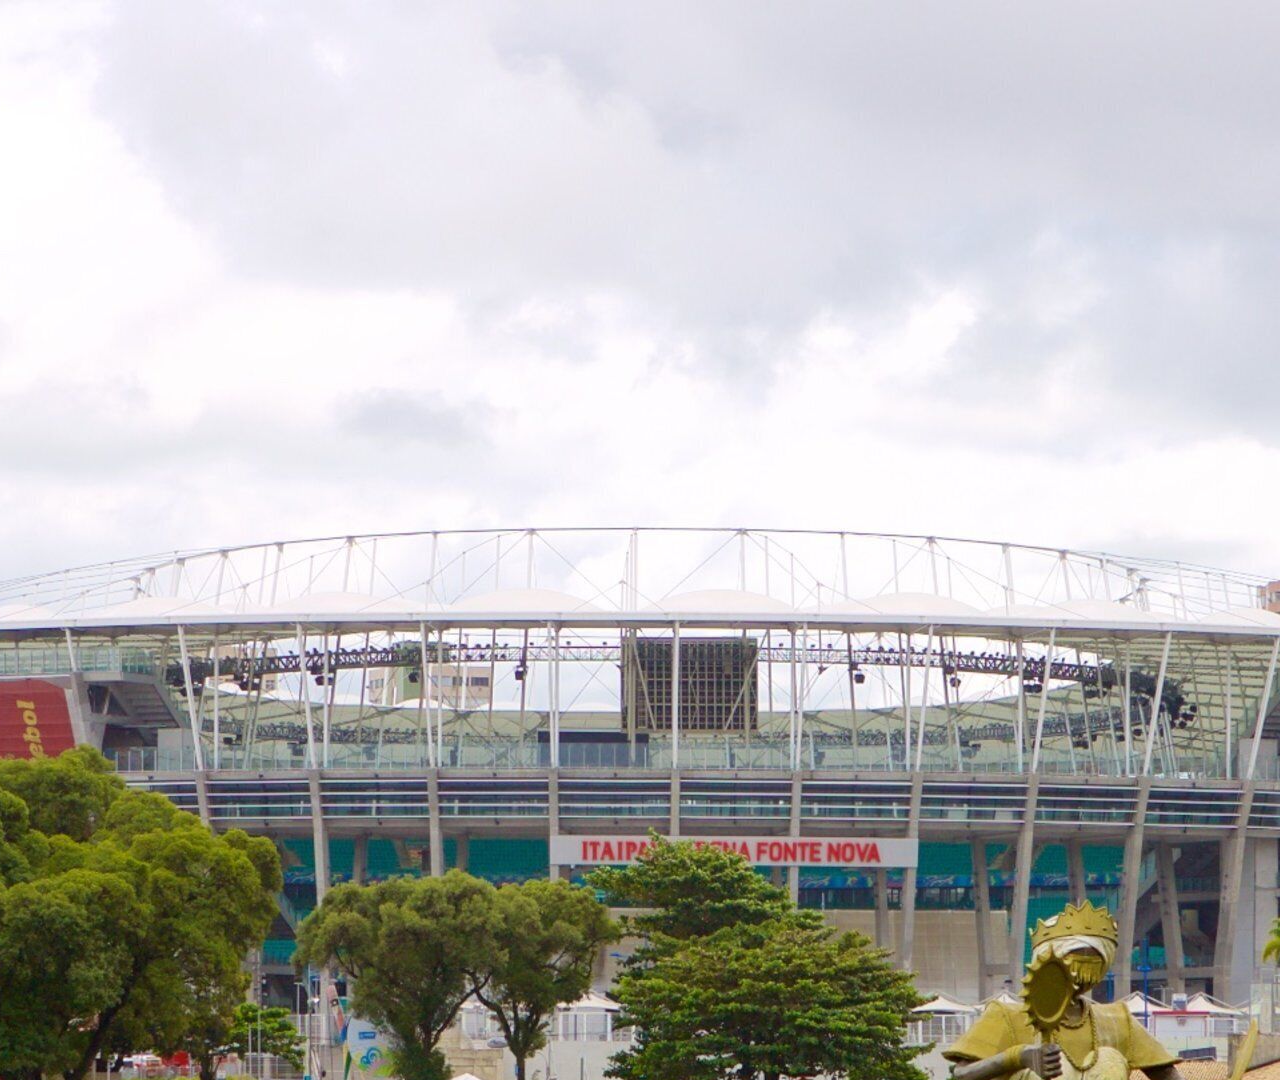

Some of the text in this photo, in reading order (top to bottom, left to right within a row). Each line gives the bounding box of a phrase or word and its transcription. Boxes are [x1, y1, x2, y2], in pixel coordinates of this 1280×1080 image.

[16, 700, 44, 757] ebol
[582, 840, 658, 861] ITAIPA
[756, 842, 822, 862] FONTE
[827, 843, 881, 863] NOVA
